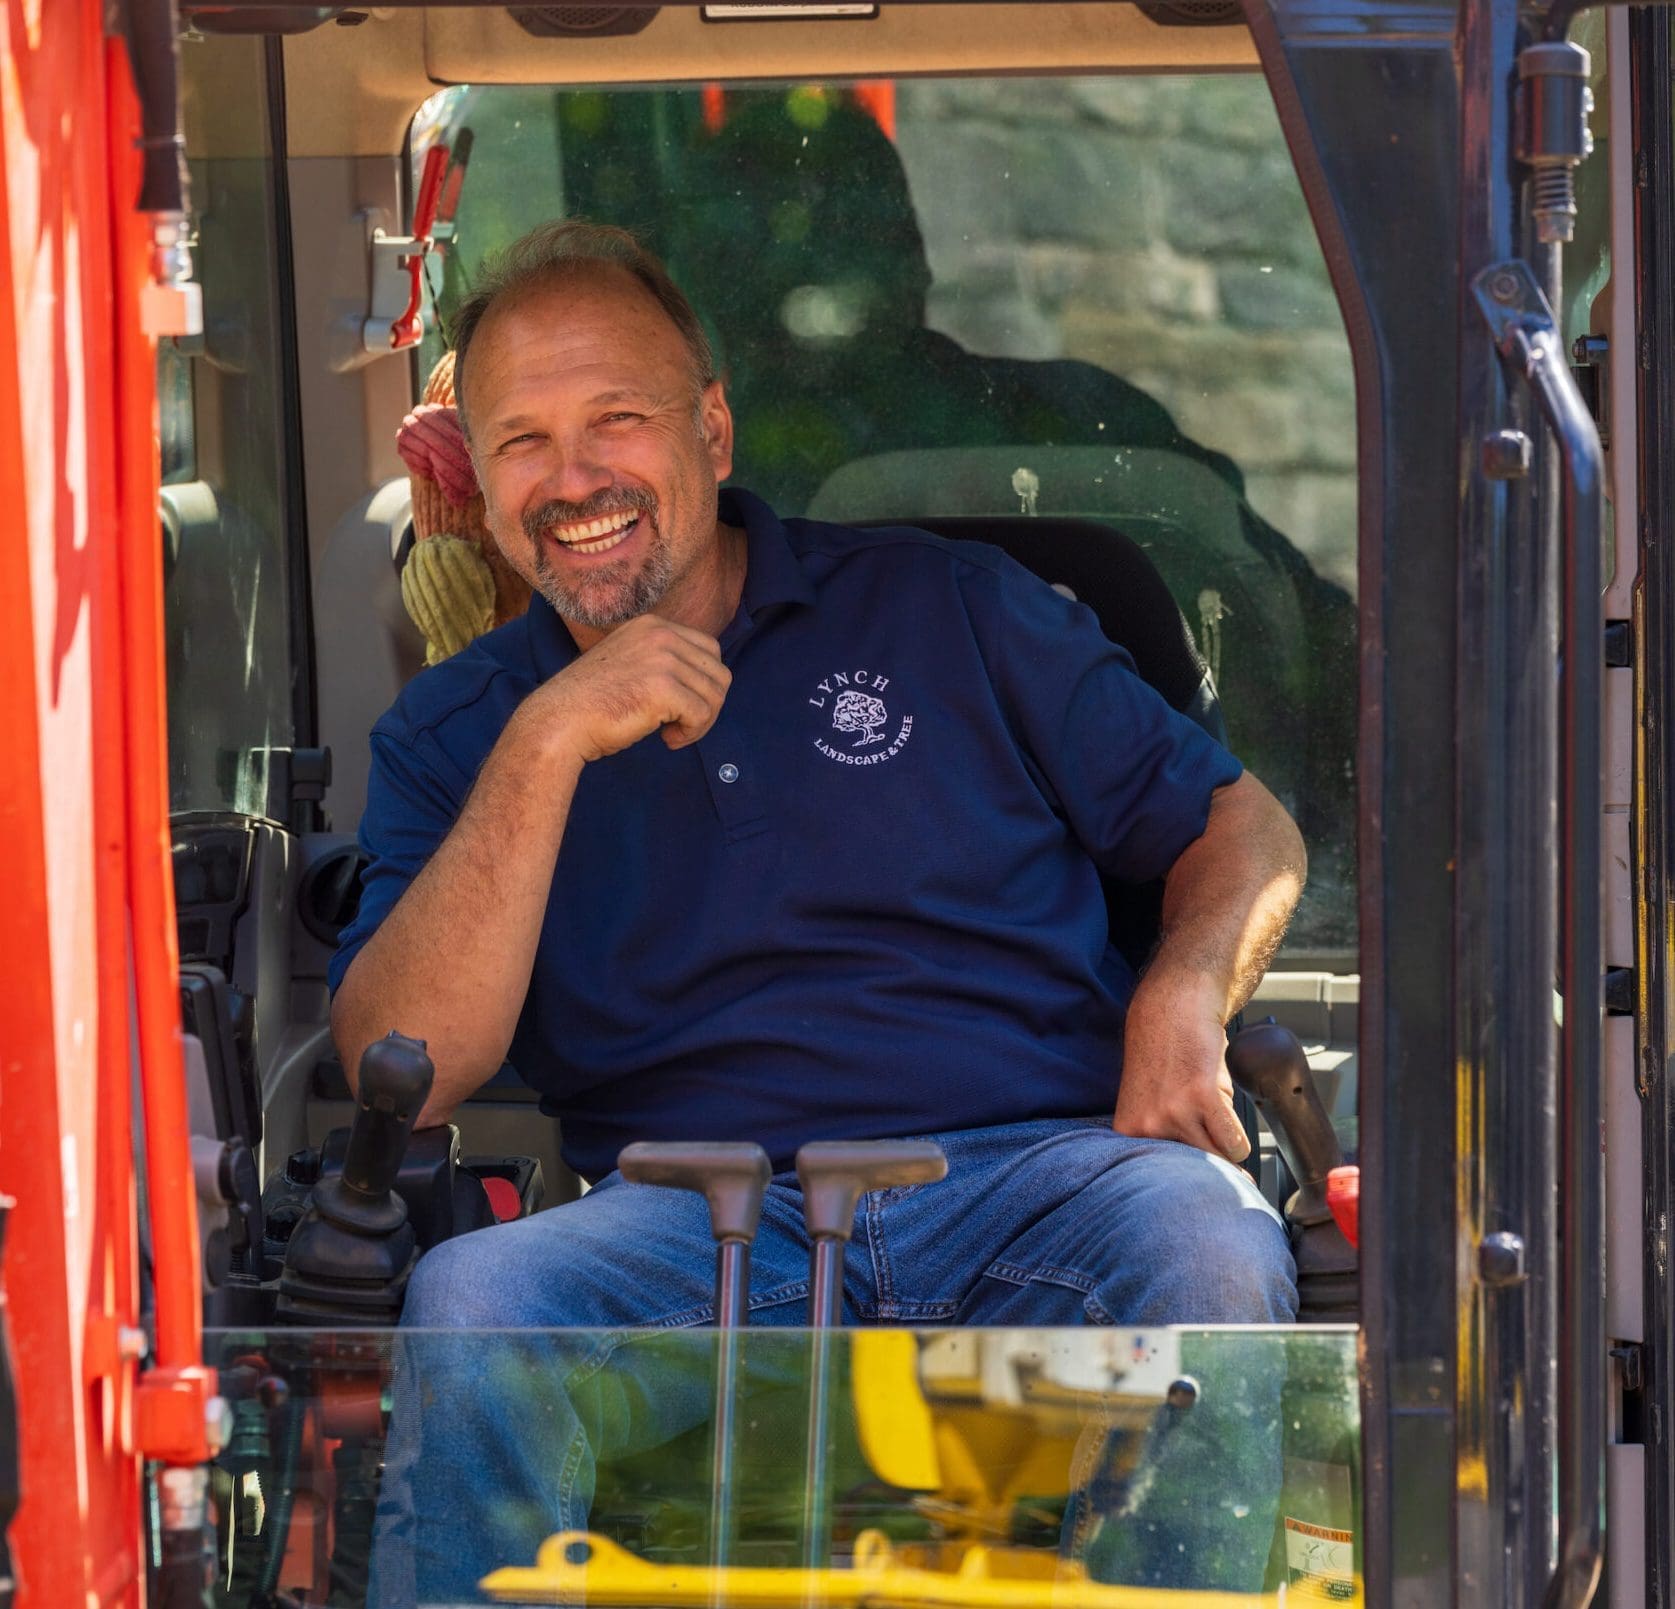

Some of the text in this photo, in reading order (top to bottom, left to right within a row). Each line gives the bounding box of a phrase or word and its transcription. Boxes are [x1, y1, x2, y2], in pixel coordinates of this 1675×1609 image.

[809, 670, 890, 708] LYNCH
[814, 738, 890, 766] LANDSCAPE
[894, 715, 913, 747] TREE
[1304, 1524, 1353, 1543] WARNIN
